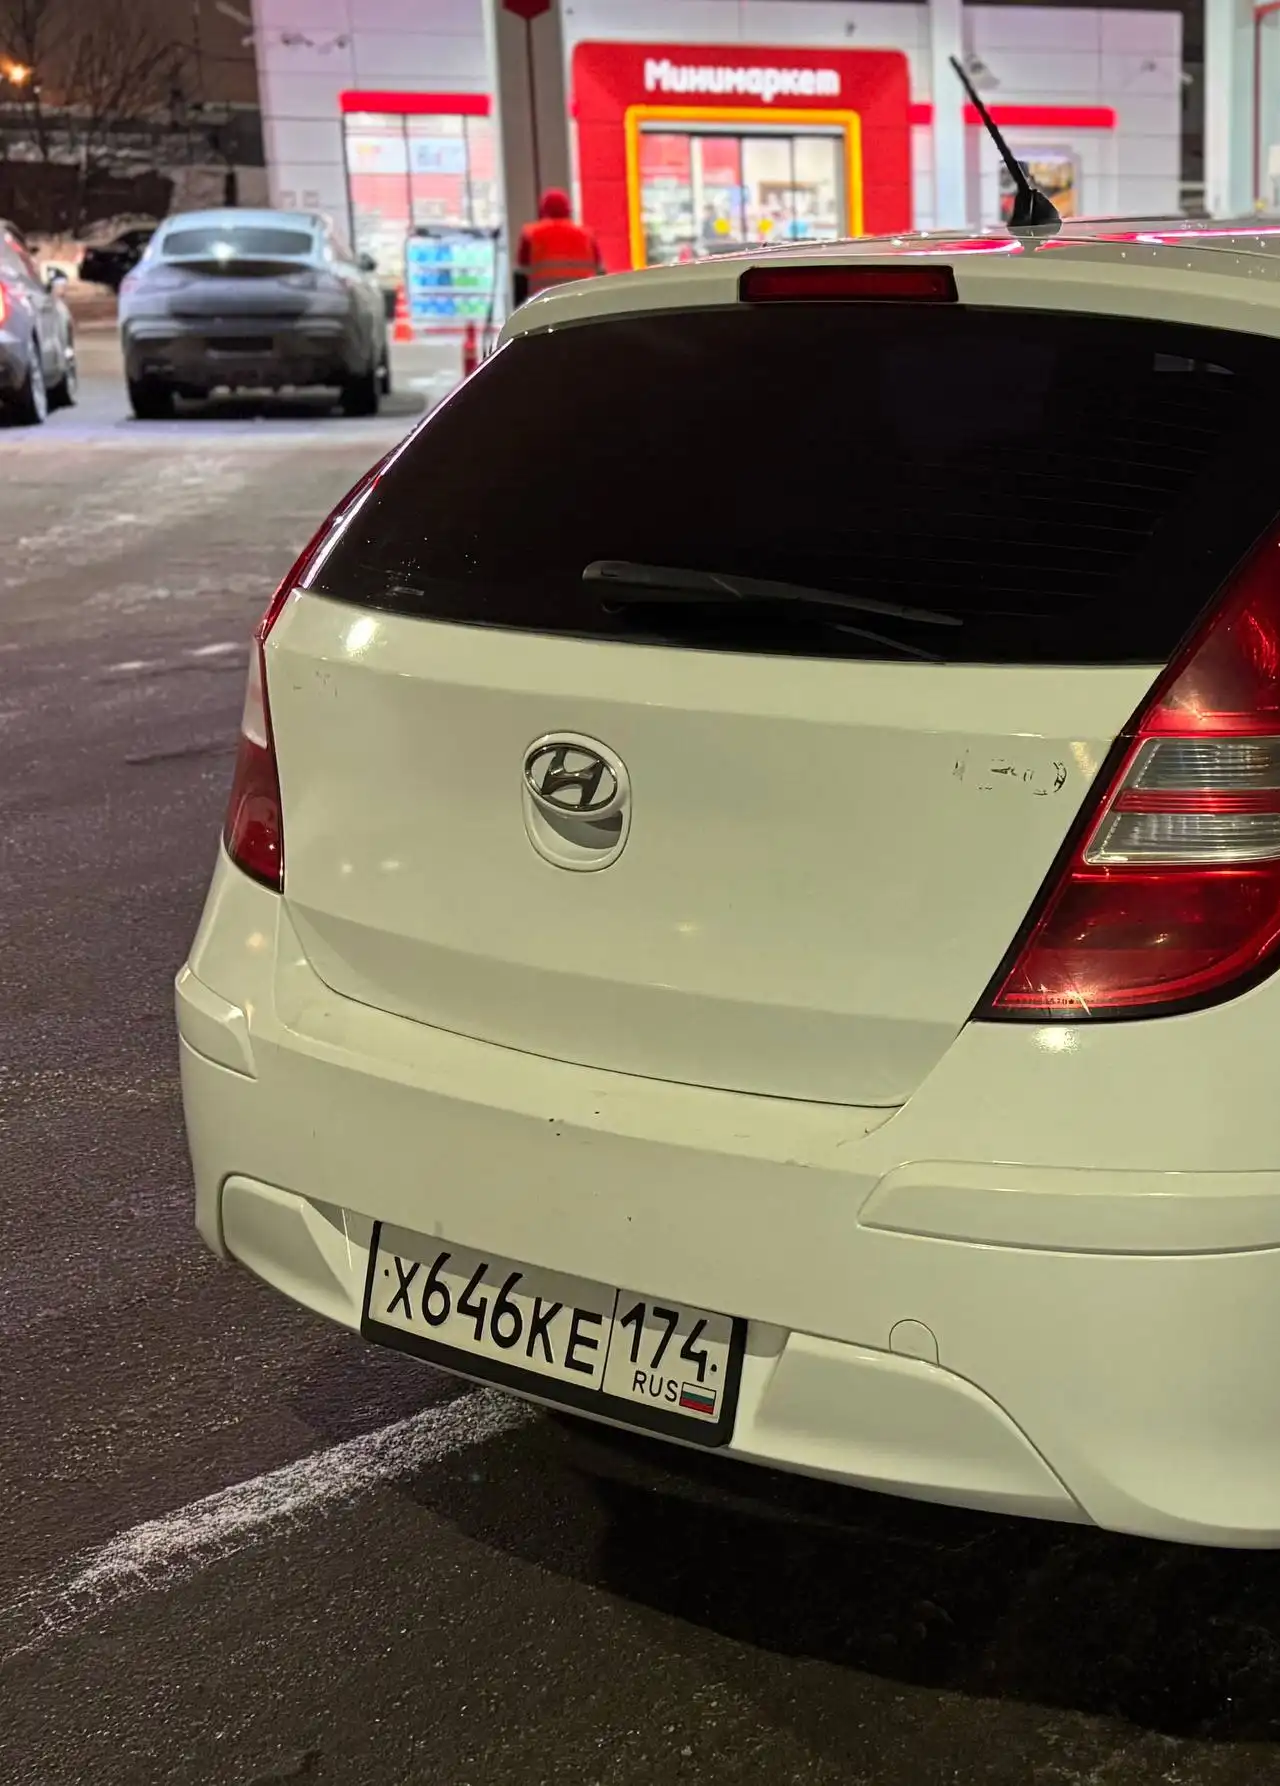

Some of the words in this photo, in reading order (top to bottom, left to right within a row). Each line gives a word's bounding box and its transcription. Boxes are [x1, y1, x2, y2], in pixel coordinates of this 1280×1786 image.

[643, 57, 840, 103] Минимаркет
[386, 1252, 602, 1376] Х646КЕ
[620, 1302, 708, 1383] 174
[632, 1371, 679, 1402] RUS
